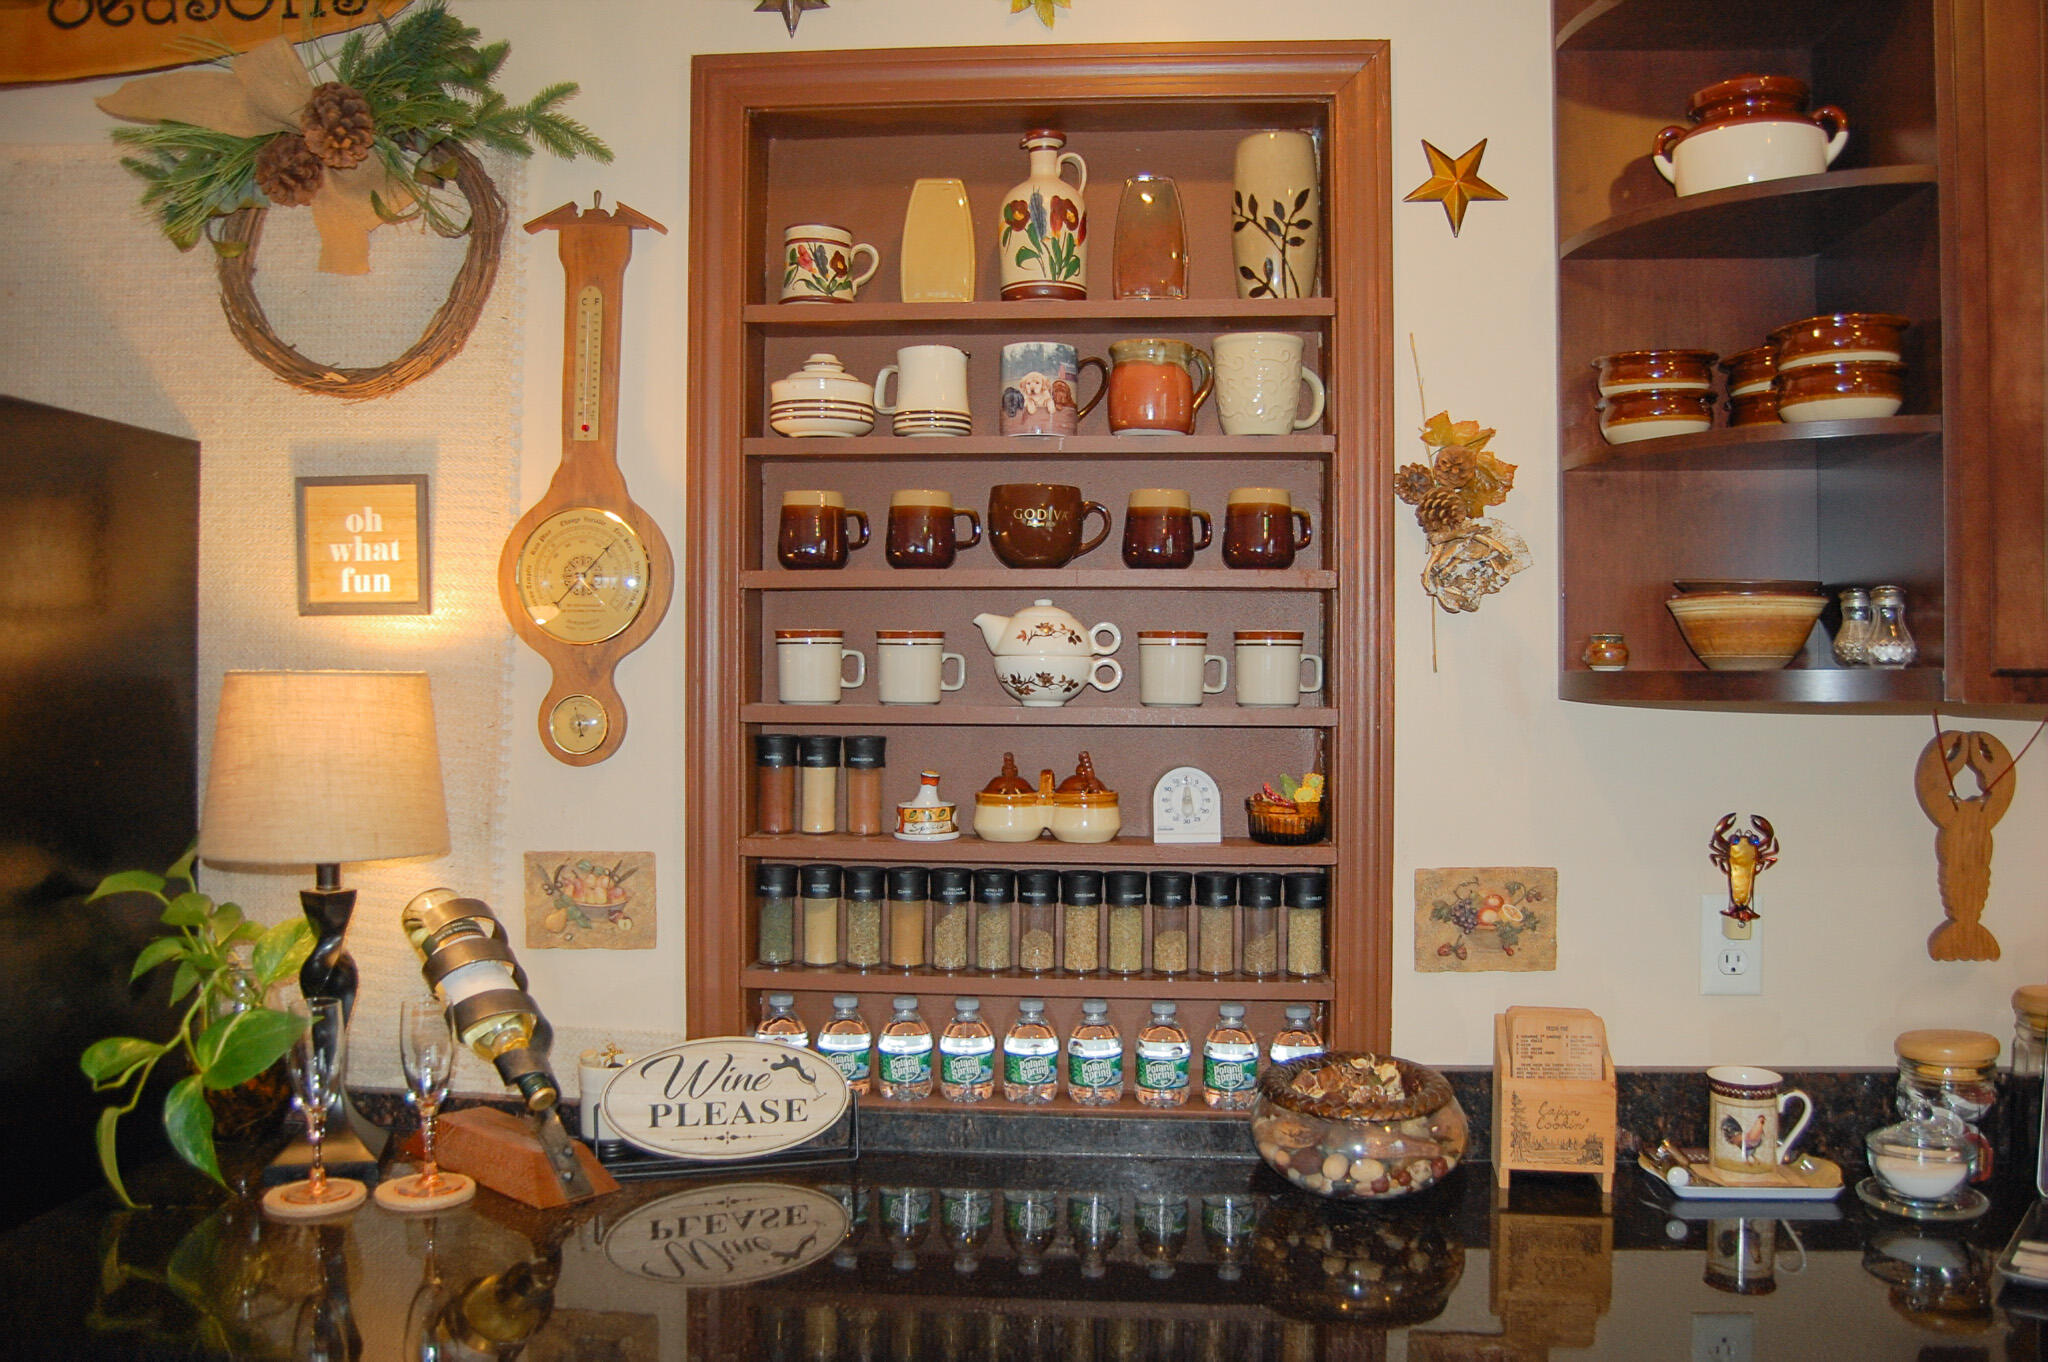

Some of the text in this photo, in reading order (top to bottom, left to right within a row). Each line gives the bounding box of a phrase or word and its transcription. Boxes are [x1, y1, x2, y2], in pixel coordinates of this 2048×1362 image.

[345, 506, 384, 533] oh
[1013, 508, 1069, 520] GODIVA
[329, 535, 400, 562] what
[341, 567, 392, 593] fun
[890, 1056, 919, 1069] Poland
[950, 1057, 979, 1070] Poland
[1020, 1057, 1048, 1070] Poland
[1082, 1060, 1111, 1072] Poland
[1146, 1062, 1174, 1074] Poland
[891, 1066, 920, 1079] Spring
[952, 1066, 980, 1079] Spring
[1021, 1066, 1049, 1080] Spring
[1083, 1068, 1111, 1083] Spring
[1213, 1064, 1242, 1076] Poland
[640, 1053, 774, 1101] Wine
[1147, 1071, 1175, 1084] Spring
[1215, 1072, 1243, 1085] Spring
[648, 1097, 809, 1128] PLEASE
